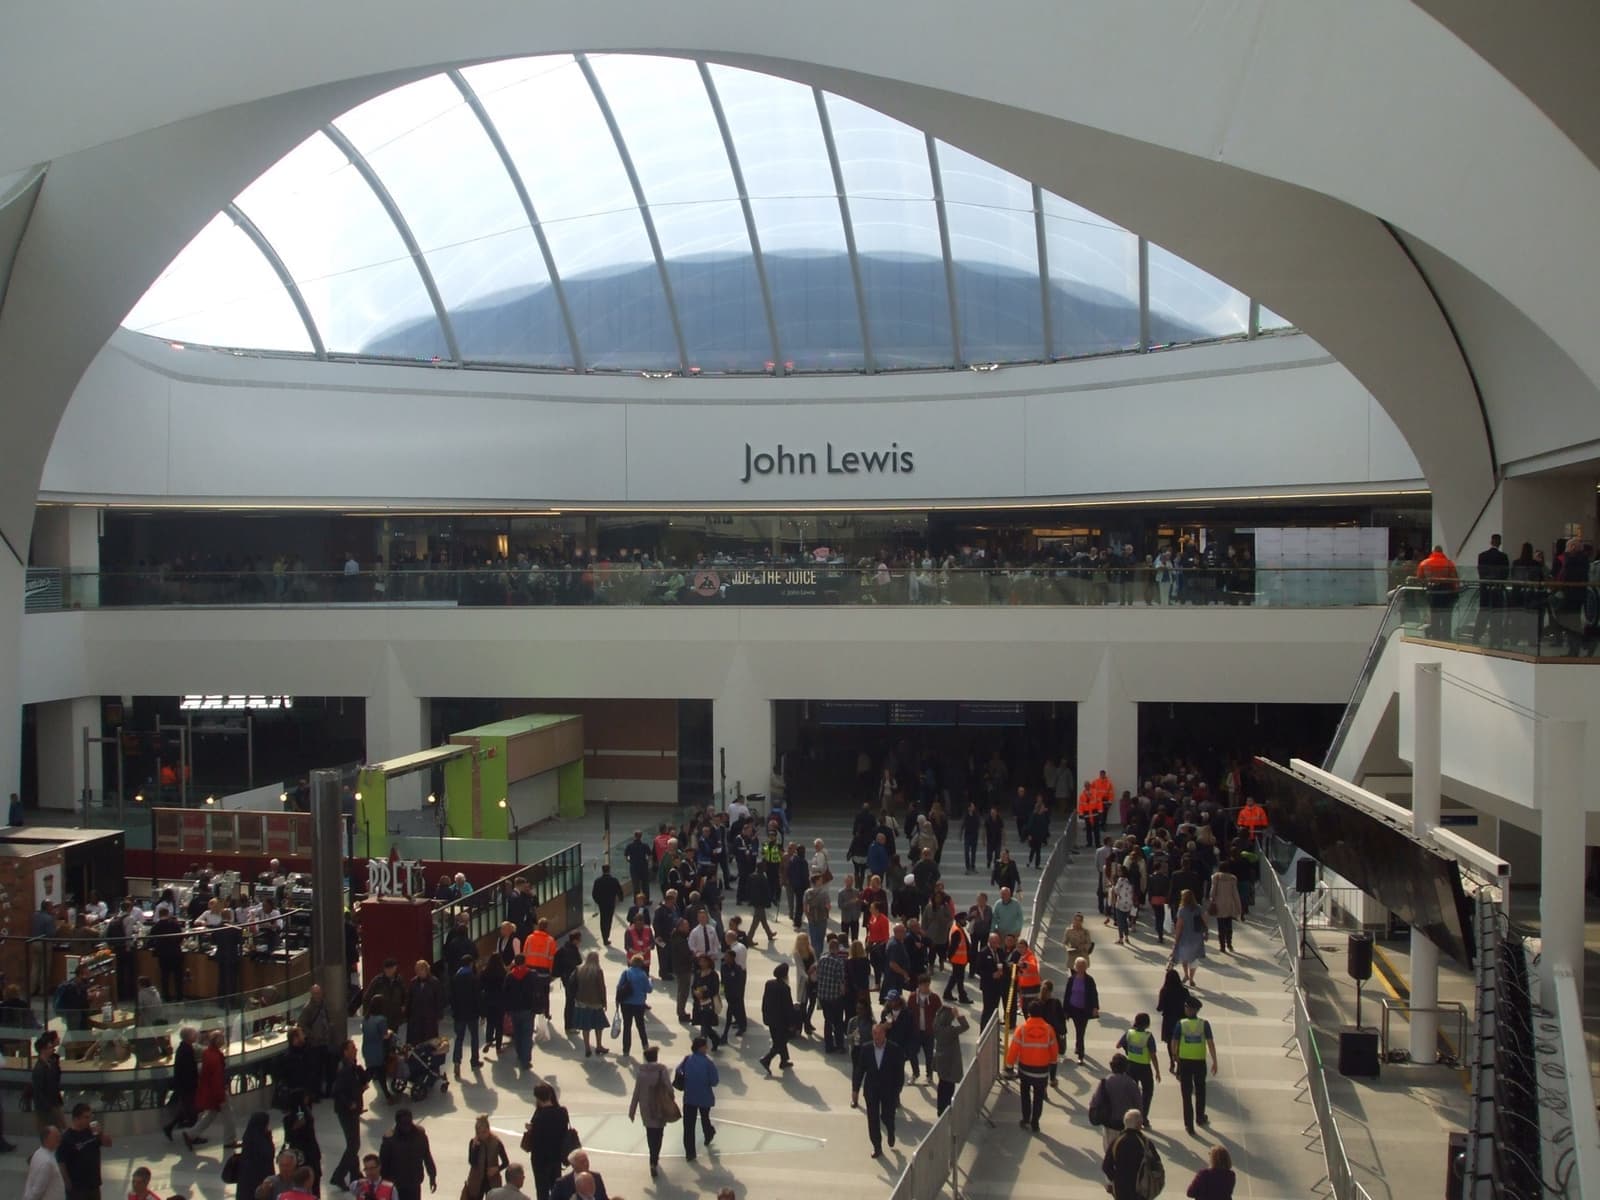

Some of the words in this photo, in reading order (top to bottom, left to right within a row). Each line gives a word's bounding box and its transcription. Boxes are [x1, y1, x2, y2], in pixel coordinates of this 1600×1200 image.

[740, 443, 817, 483] John
[826, 441, 914, 474] Lewis
[732, 570, 751, 585] JOE
[760, 570, 781, 585] THE
[785, 570, 817, 585] JUICE
[368, 859, 416, 896] PRET
